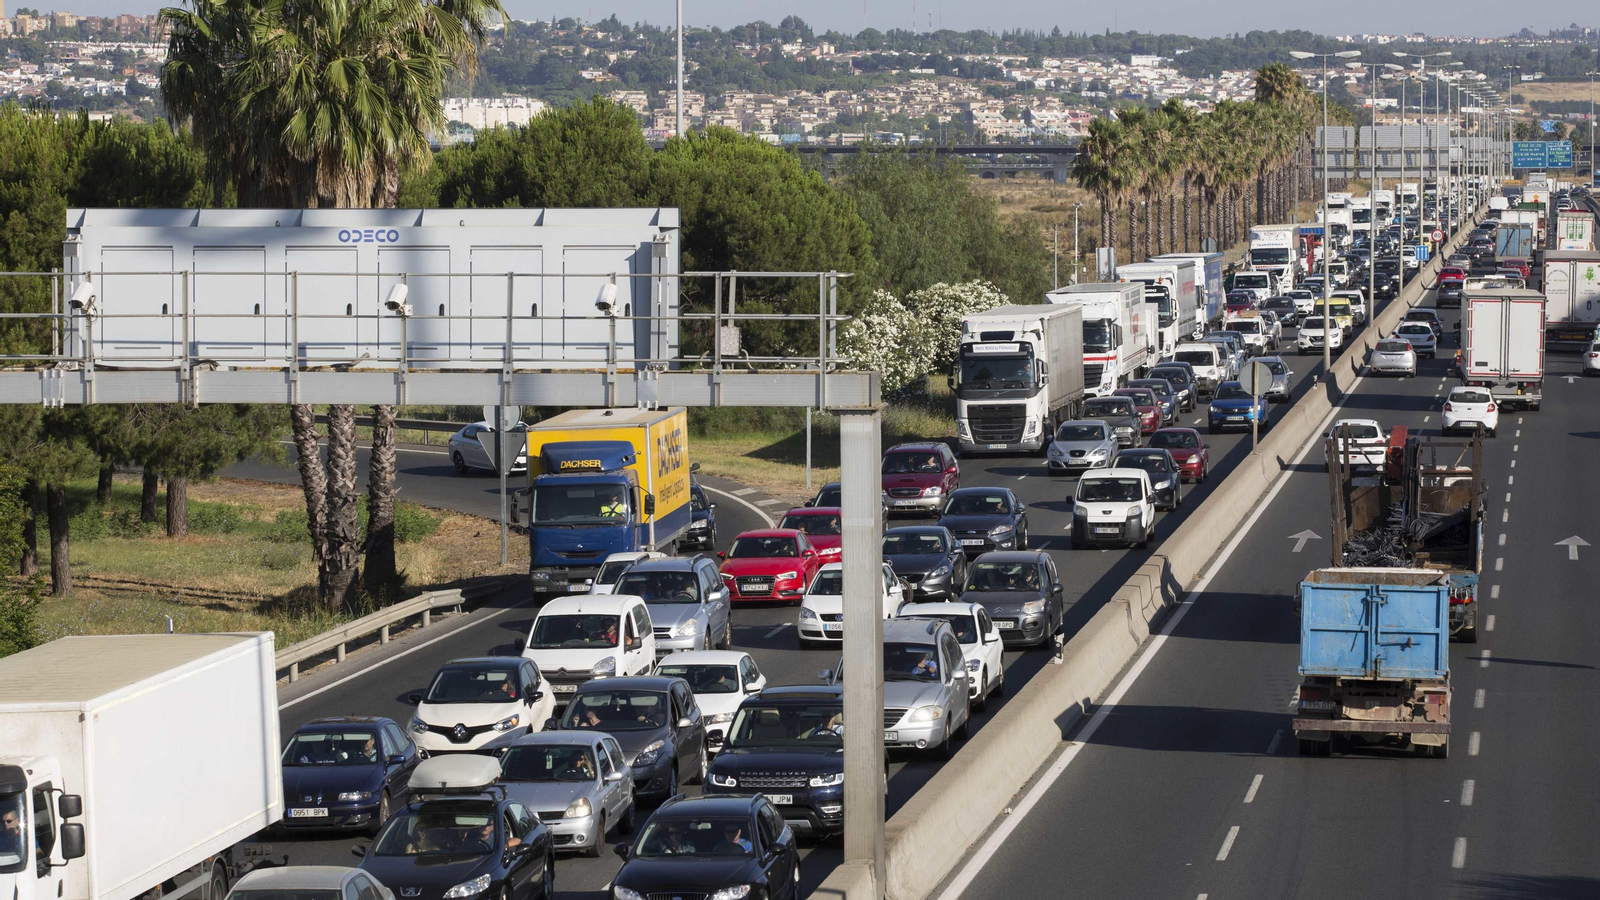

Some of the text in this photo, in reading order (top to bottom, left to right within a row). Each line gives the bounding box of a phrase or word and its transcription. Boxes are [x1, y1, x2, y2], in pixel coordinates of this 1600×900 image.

[338, 229, 400, 243] ODECO
[657, 428, 684, 478] DACHSER
[560, 459, 602, 469] DACHSER
[313, 808, 326, 816] BPK
